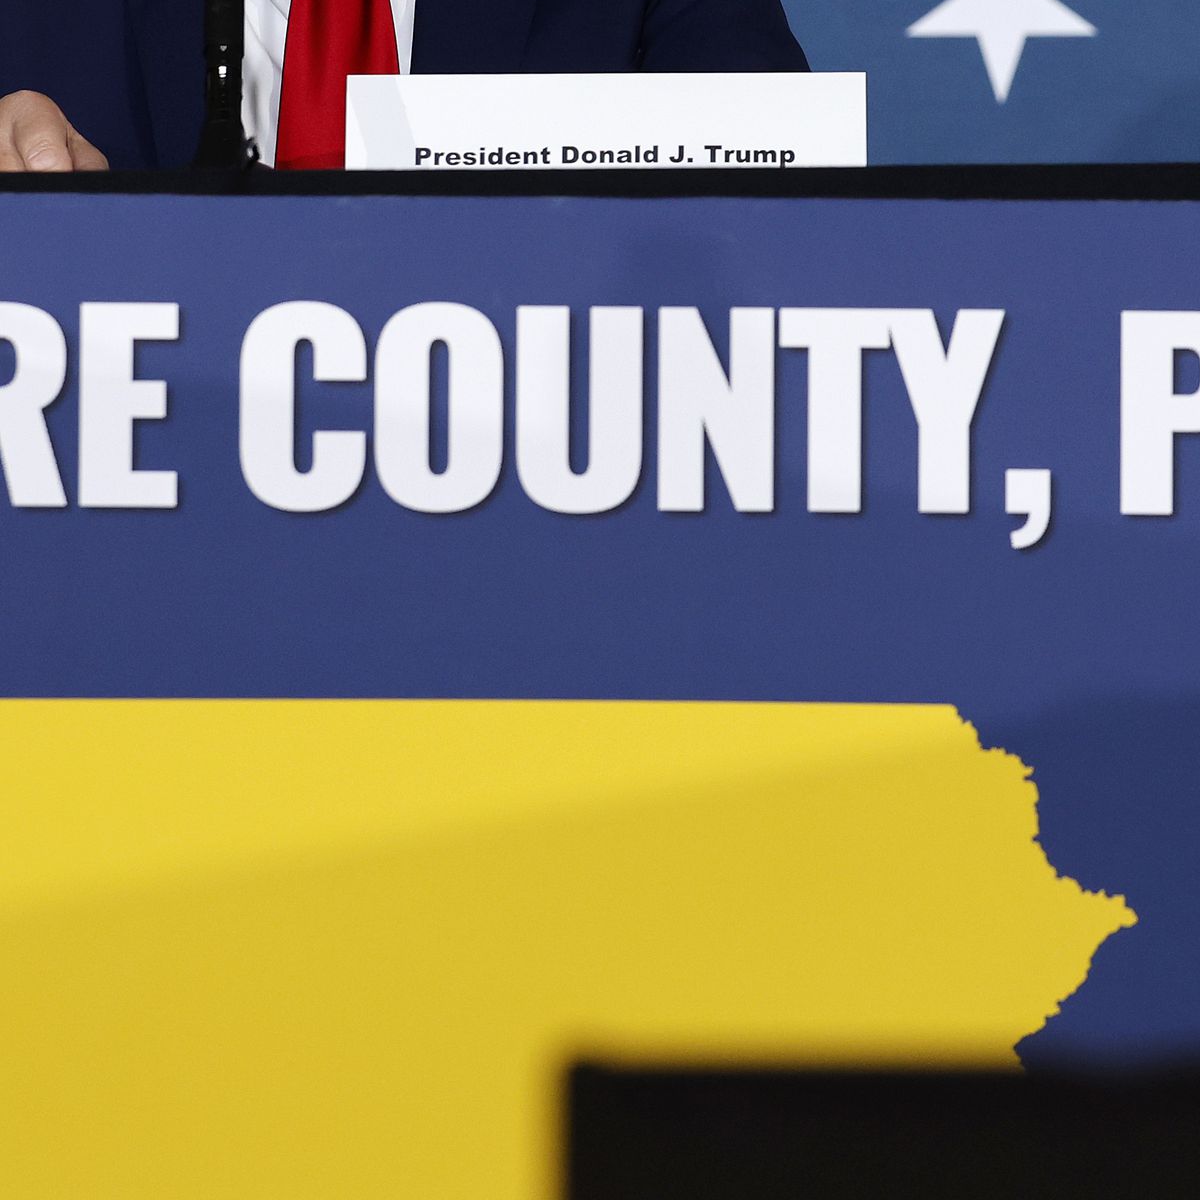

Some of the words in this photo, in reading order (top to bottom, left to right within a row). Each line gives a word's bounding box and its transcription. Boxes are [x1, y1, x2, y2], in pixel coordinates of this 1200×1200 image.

[414, 147, 551, 166] President
[561, 145, 659, 164] Donald
[669, 145, 694, 164] J.
[704, 145, 796, 168] Trump
[239, 300, 1052, 550] COUNTY,
